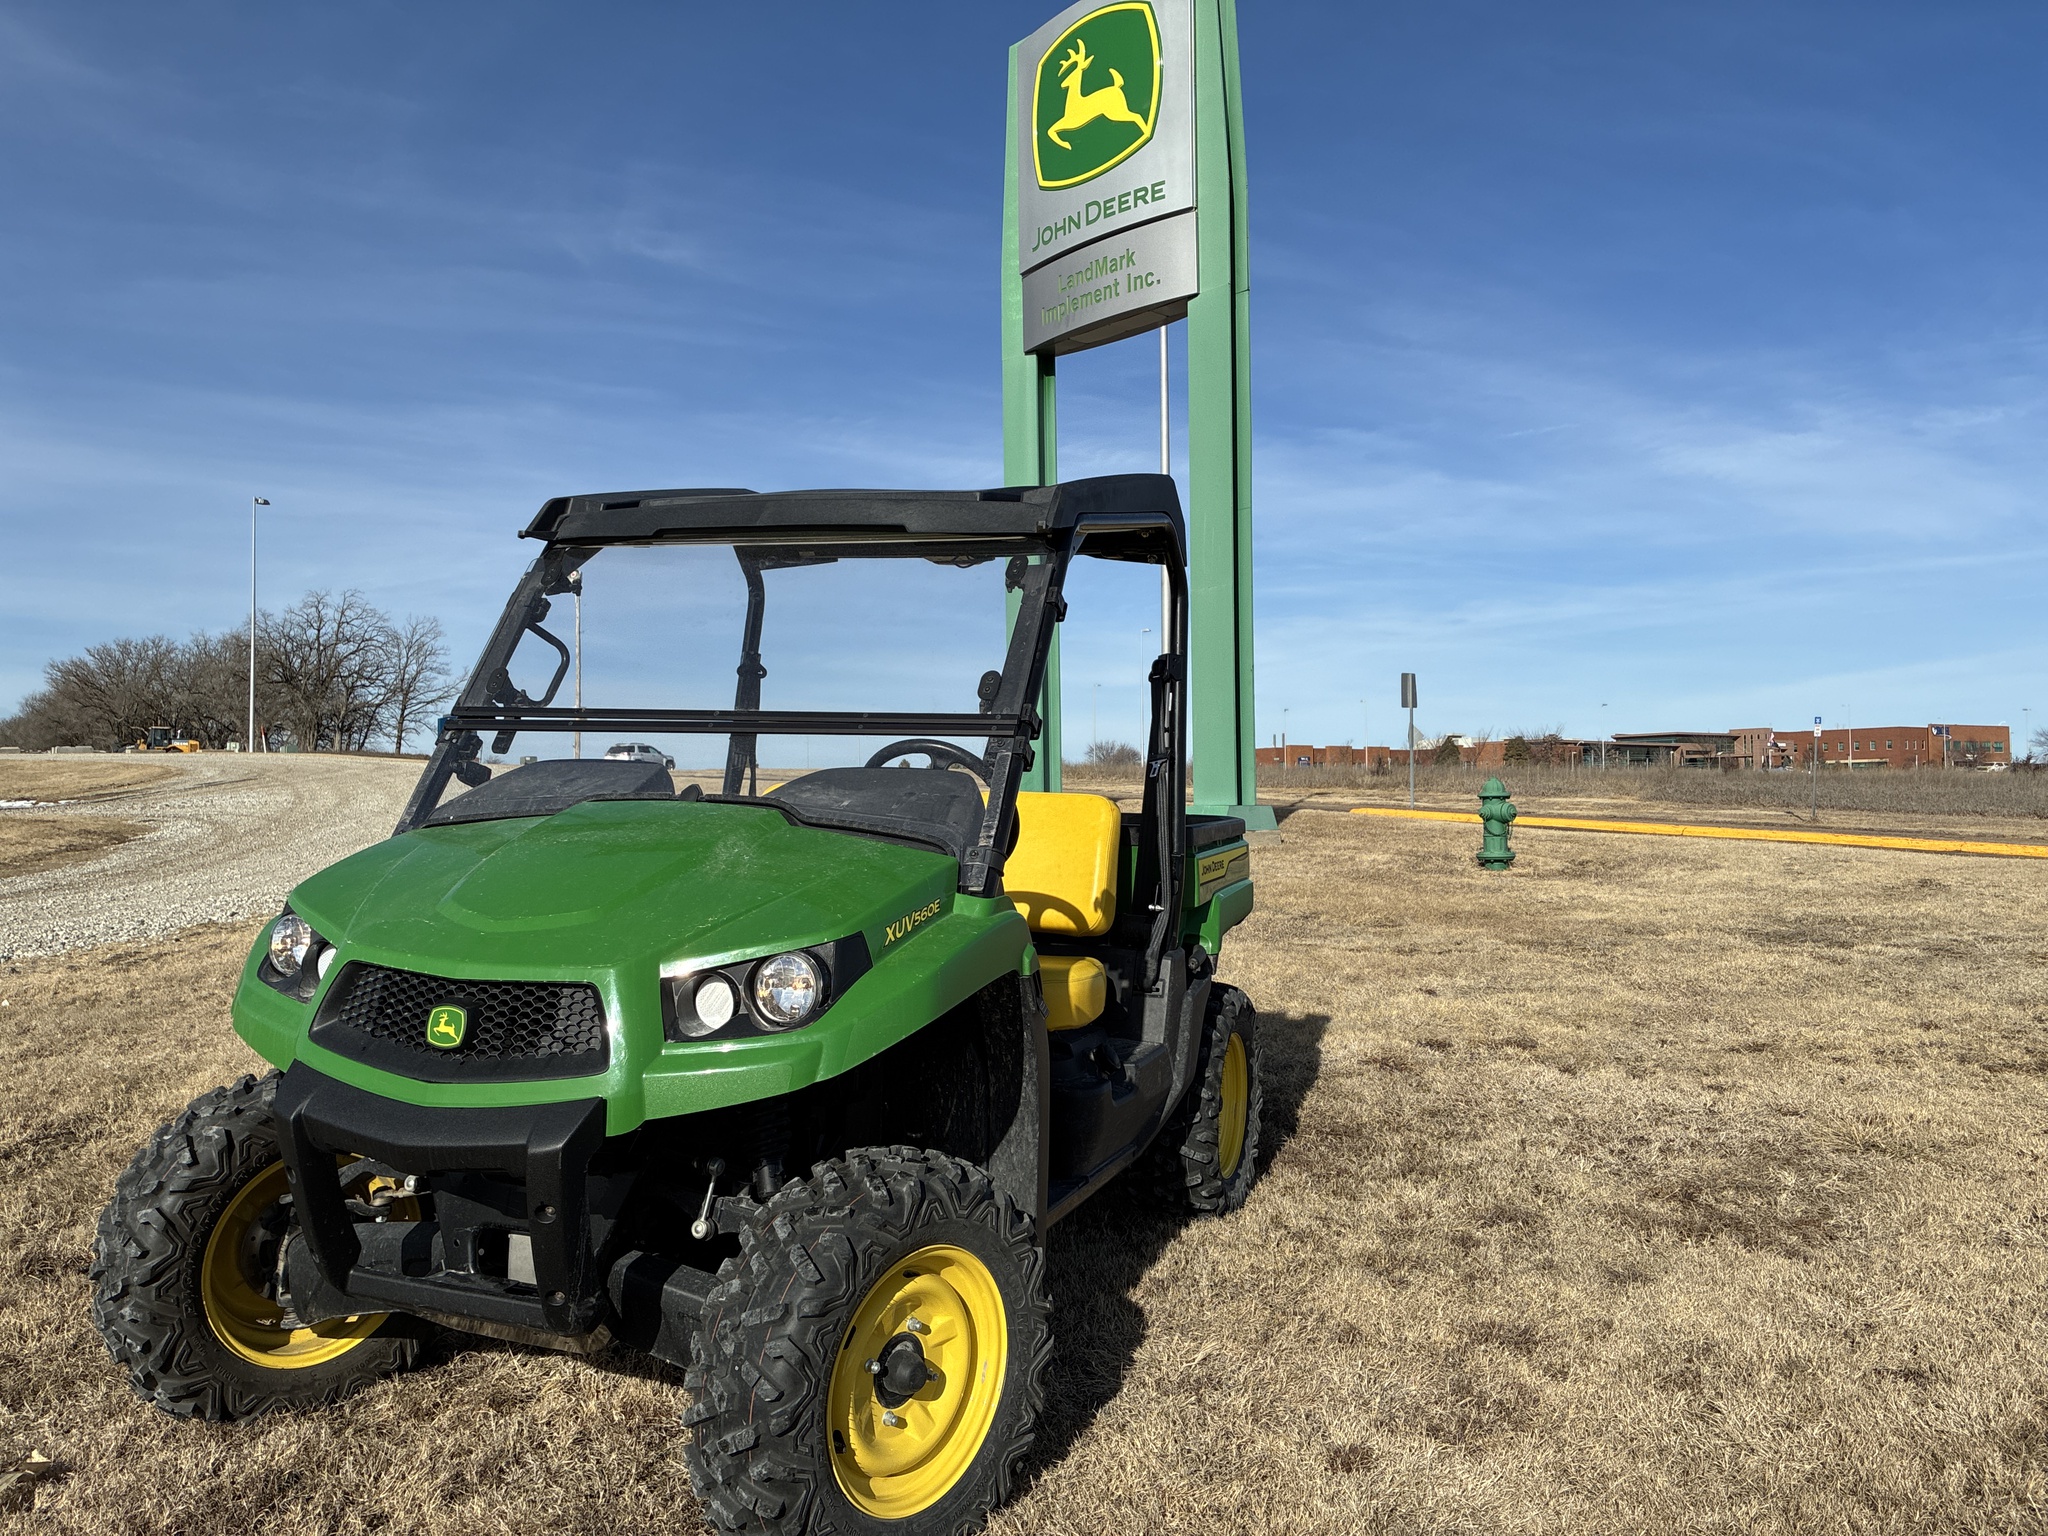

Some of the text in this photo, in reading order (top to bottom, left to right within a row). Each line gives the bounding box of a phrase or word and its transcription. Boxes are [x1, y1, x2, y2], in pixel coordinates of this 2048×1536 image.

[1032, 180, 1166, 252] JOHN DEERE
[1058, 248, 1136, 294] LandMark
[1041, 271, 1161, 326] Implement Inc.
[1201, 860, 1225, 876] JOHN DEERE
[884, 897, 941, 948] XUV560E
